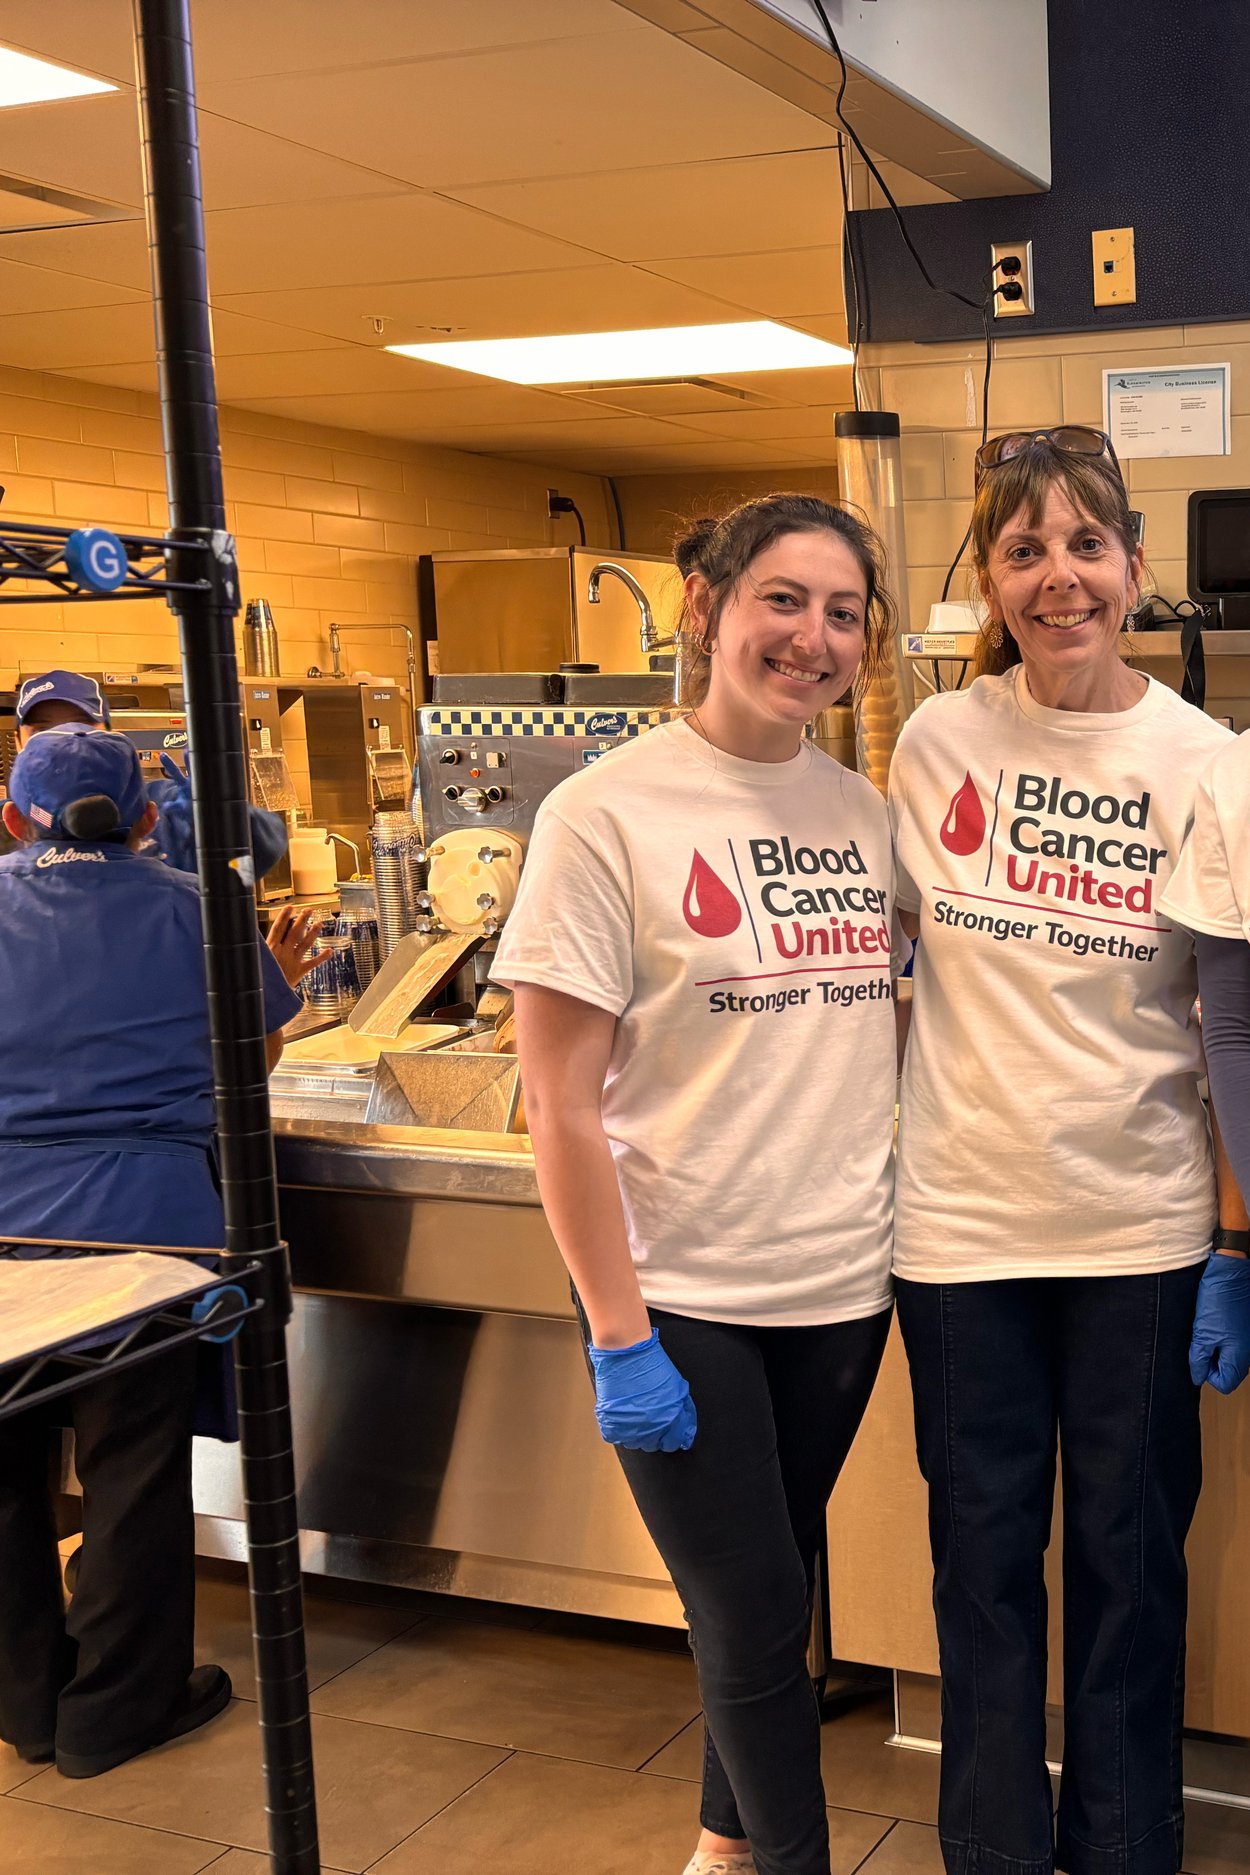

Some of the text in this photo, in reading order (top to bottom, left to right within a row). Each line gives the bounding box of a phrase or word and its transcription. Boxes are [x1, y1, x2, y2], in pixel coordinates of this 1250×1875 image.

[90, 540, 119, 578] G
[1014, 773, 1151, 831] Blood
[37, 847, 108, 868] Culver's
[749, 836, 868, 876] Blood
[1010, 816, 1167, 874] Cancer
[761, 882, 886, 917] Cancer
[1007, 854, 1152, 914] United
[771, 916, 890, 959] United
[934, 901, 1159, 962] Stronger Together
[709, 977, 894, 1013] Stronger Togeth
